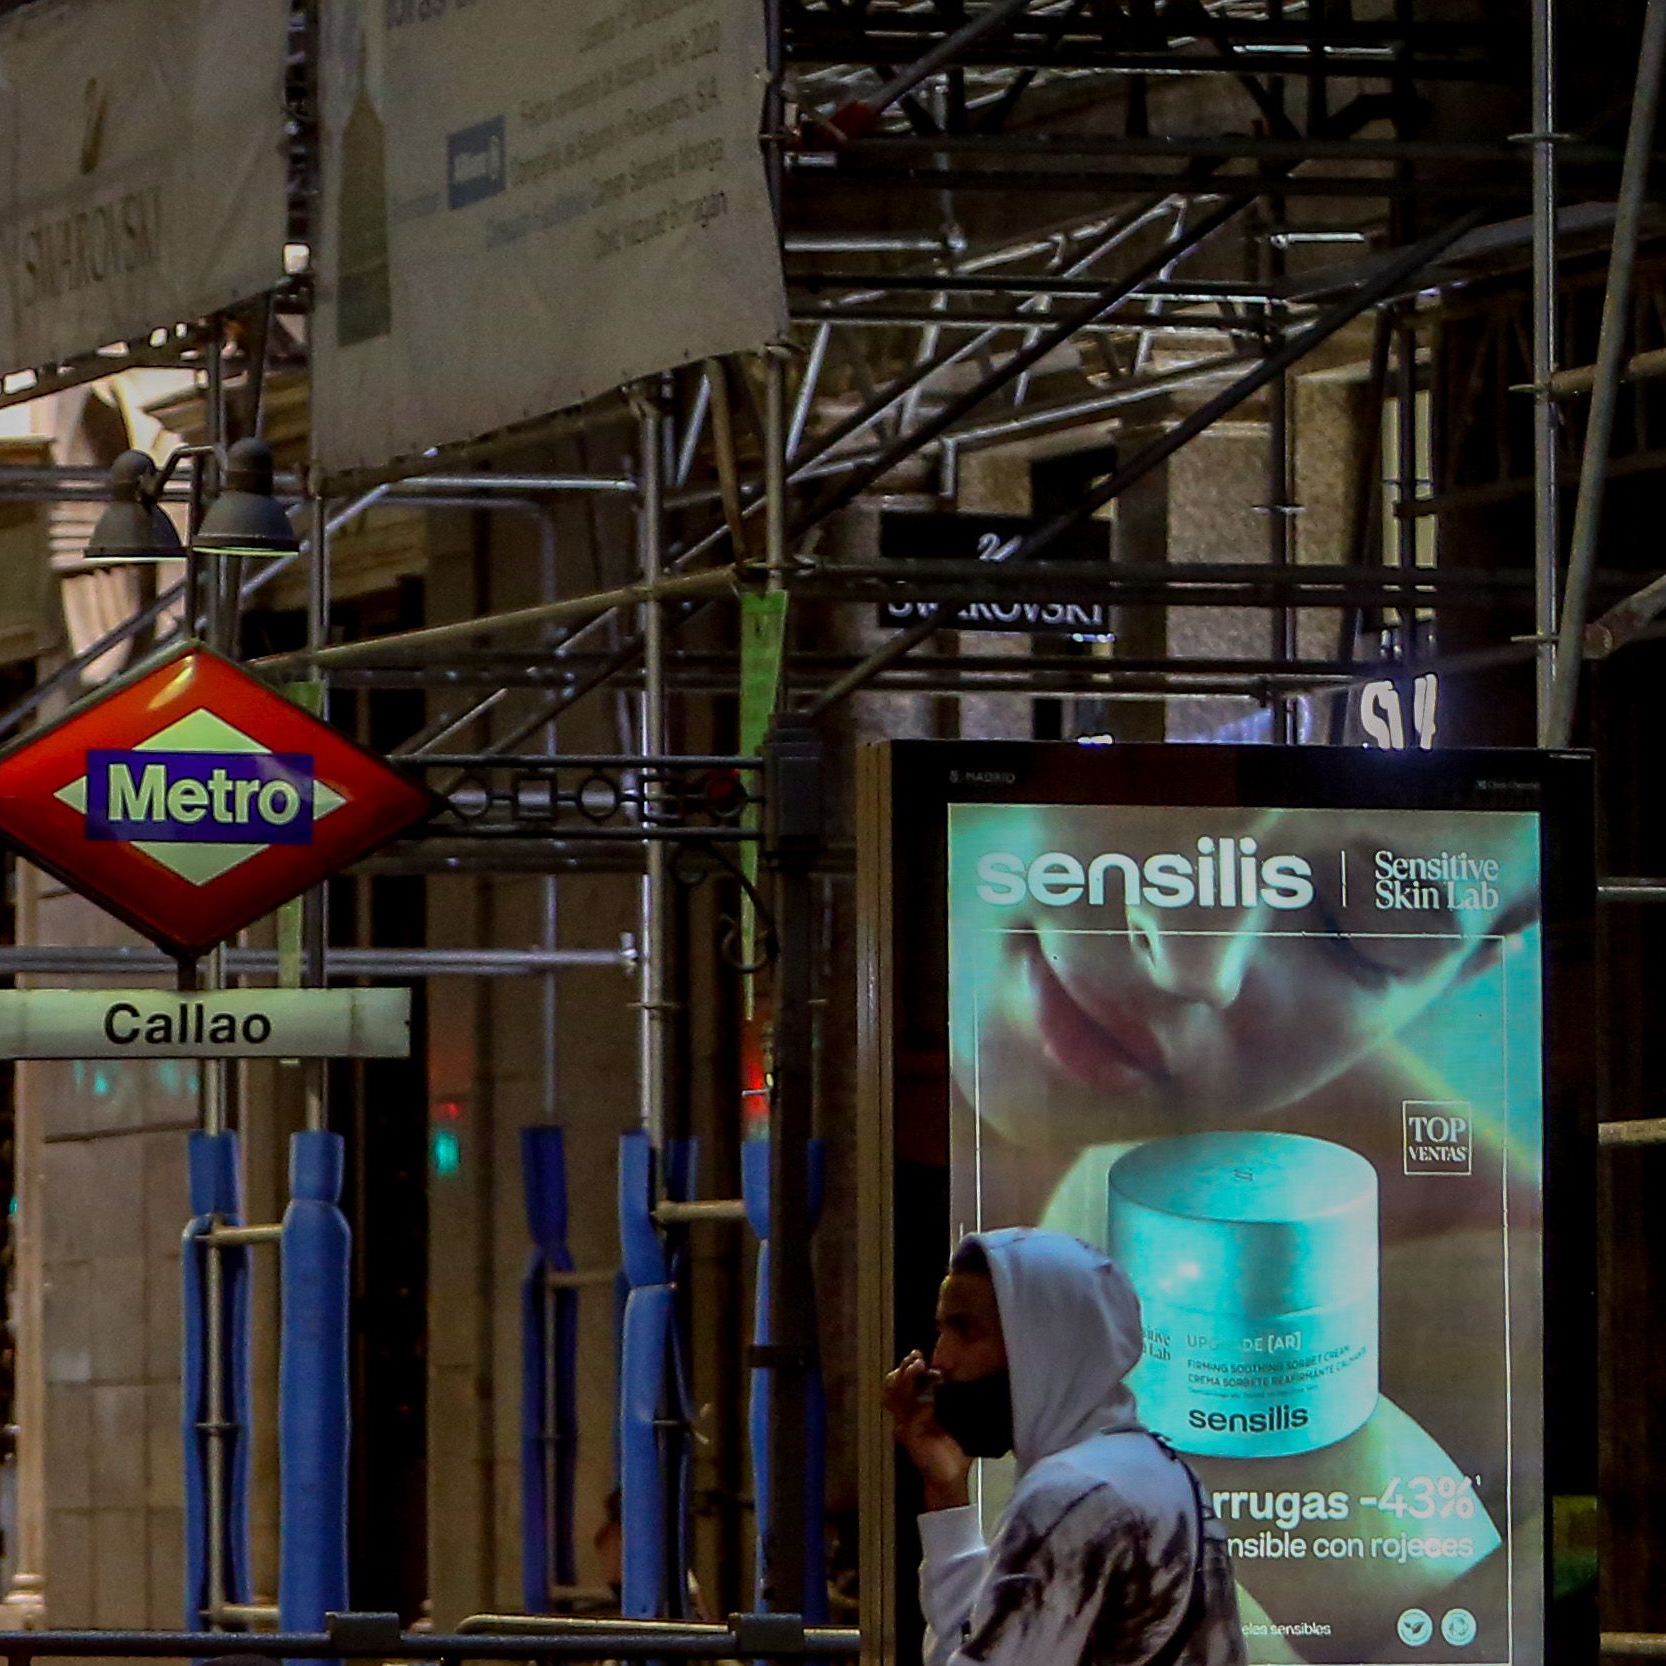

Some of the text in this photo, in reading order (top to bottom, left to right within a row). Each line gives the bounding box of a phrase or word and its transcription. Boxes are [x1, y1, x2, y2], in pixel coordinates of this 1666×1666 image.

[107, 763, 301, 826] Metro
[975, 836, 1314, 910] sensilis
[1375, 850, 1500, 881] Sensitive
[1375, 880, 1500, 911] Skin Lab
[104, 1002, 272, 1045] Callao
[1408, 1116, 1467, 1143] TOP
[1408, 1146, 1468, 1162] VENTAS
[1189, 1404, 1309, 1433] sensilis
[1227, 1531, 1475, 1564] nsible con rojeces
[1269, 1622, 1332, 1636] sensibles
